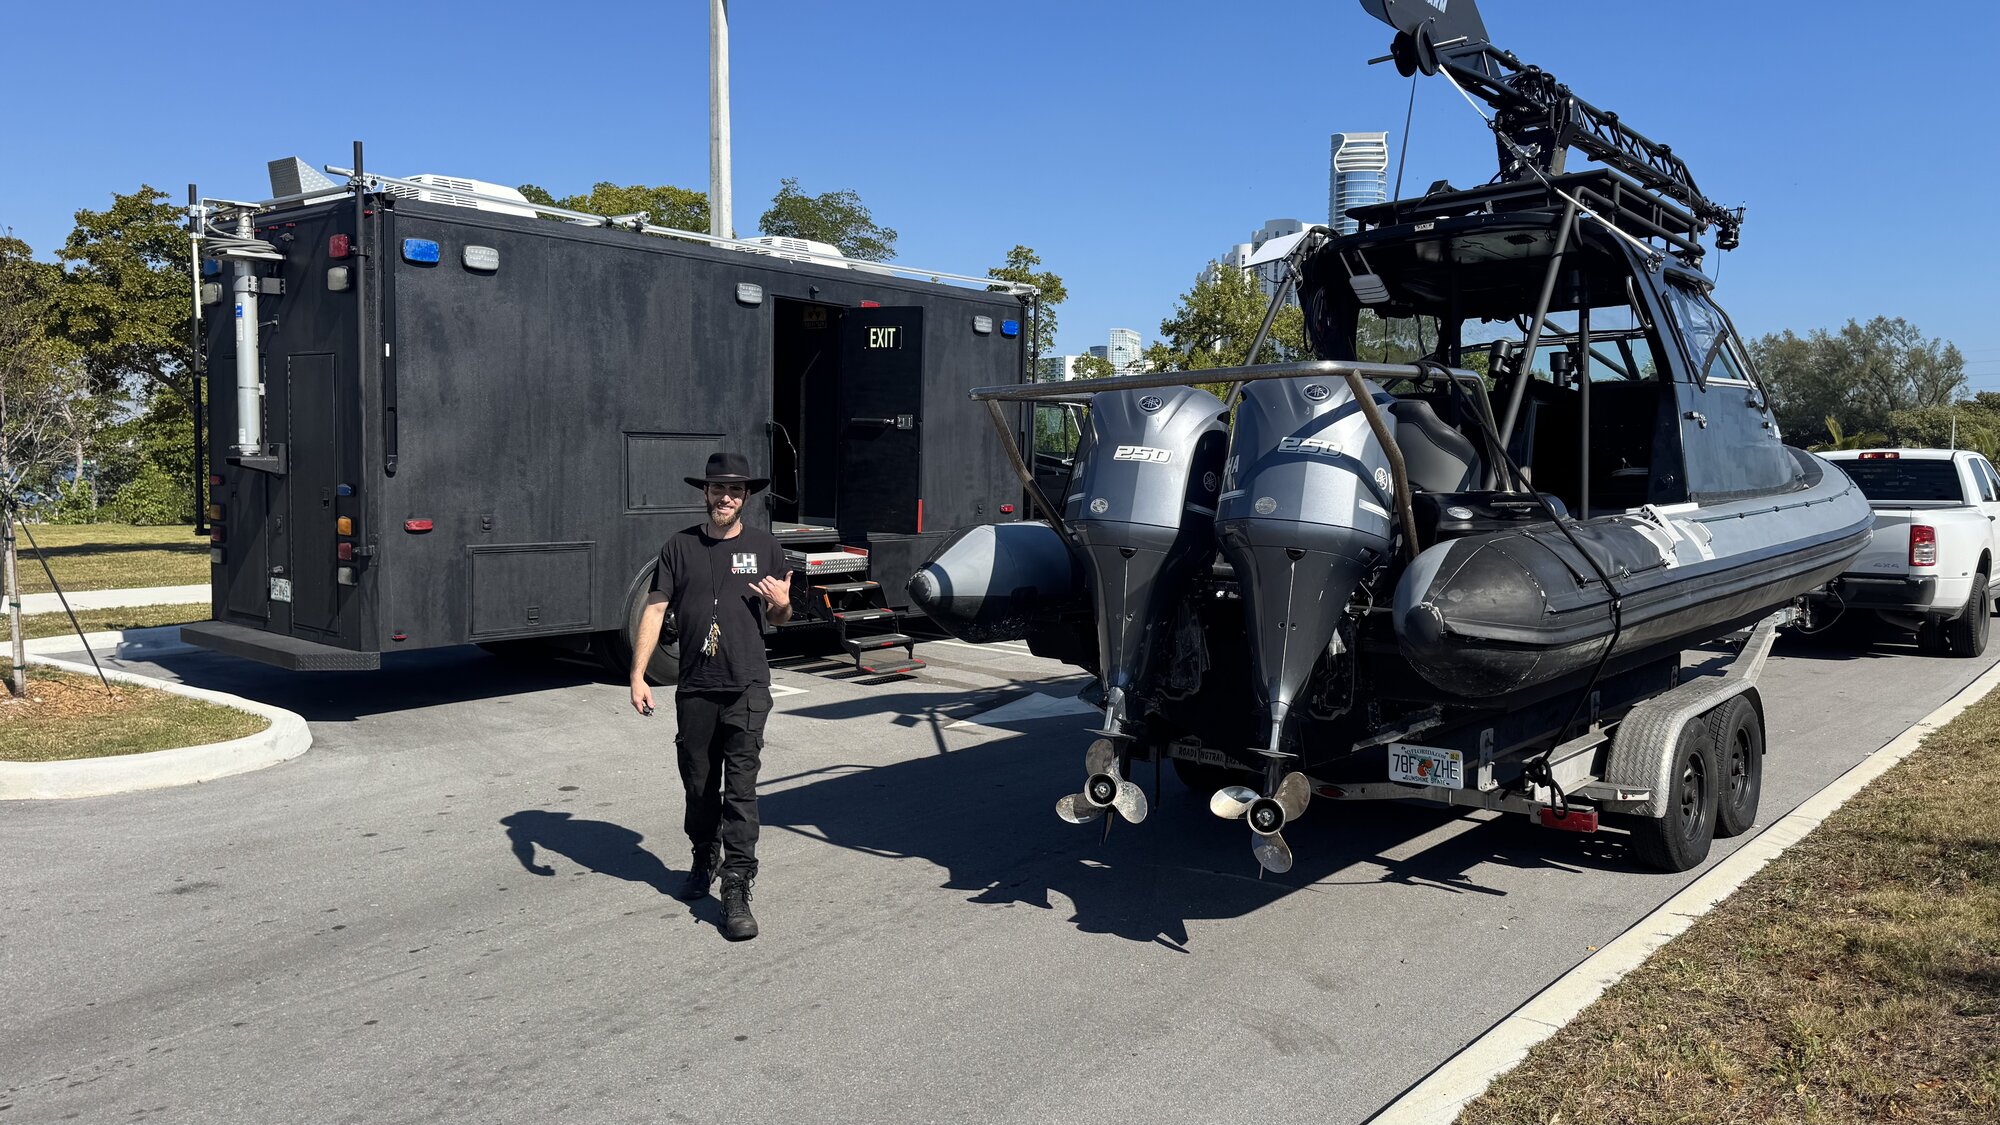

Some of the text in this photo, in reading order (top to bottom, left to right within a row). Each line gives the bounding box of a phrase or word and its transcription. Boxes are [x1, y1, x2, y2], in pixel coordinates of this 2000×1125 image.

[870, 328, 896, 348] EXIT
[1114, 446, 1173, 464] 250
[1277, 437, 1344, 459] 250
[732, 553, 757, 567] LH
[1392, 753, 1460, 780] 78F ZHE
